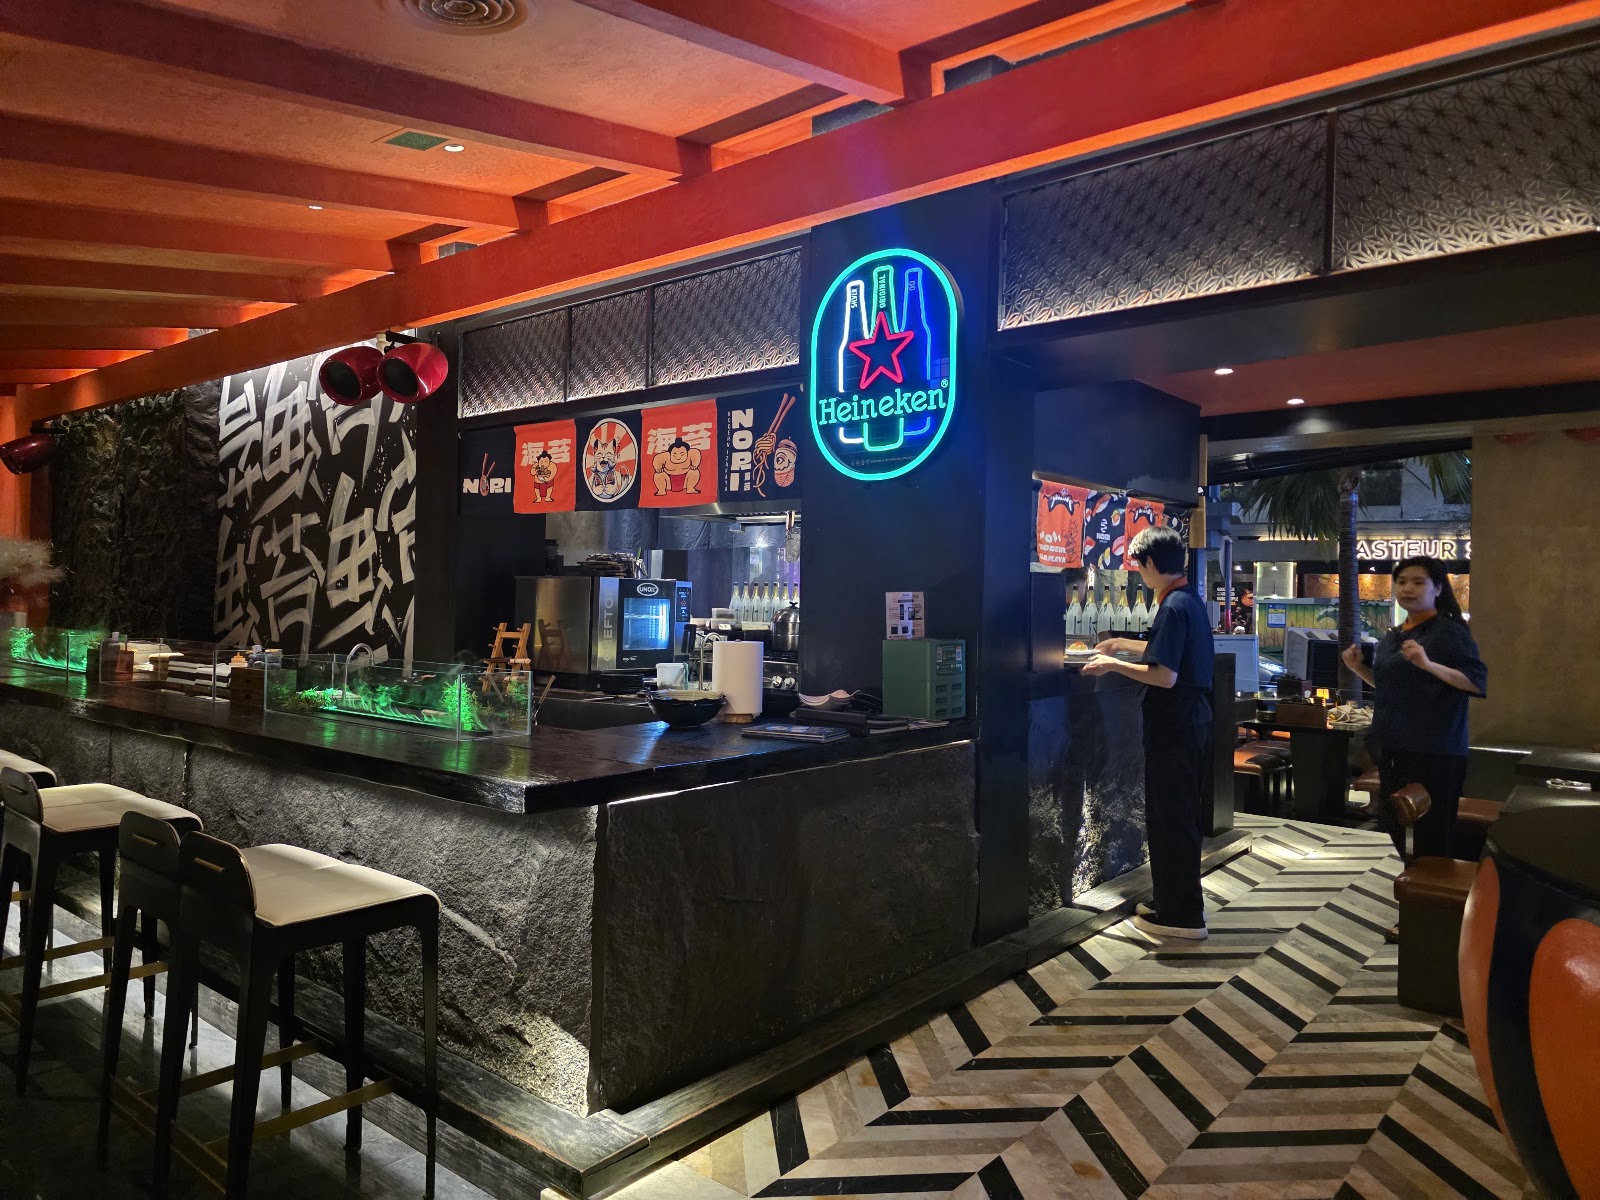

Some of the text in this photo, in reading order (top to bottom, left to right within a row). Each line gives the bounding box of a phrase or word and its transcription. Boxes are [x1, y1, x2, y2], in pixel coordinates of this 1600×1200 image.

[850, 288, 858, 309] SILVER
[879, 274, 887, 308] ORIGINAL
[818, 388, 946, 425] Heineken
[729, 408, 754, 492] NORI
[1356, 539, 1457, 560] ASTEUR
